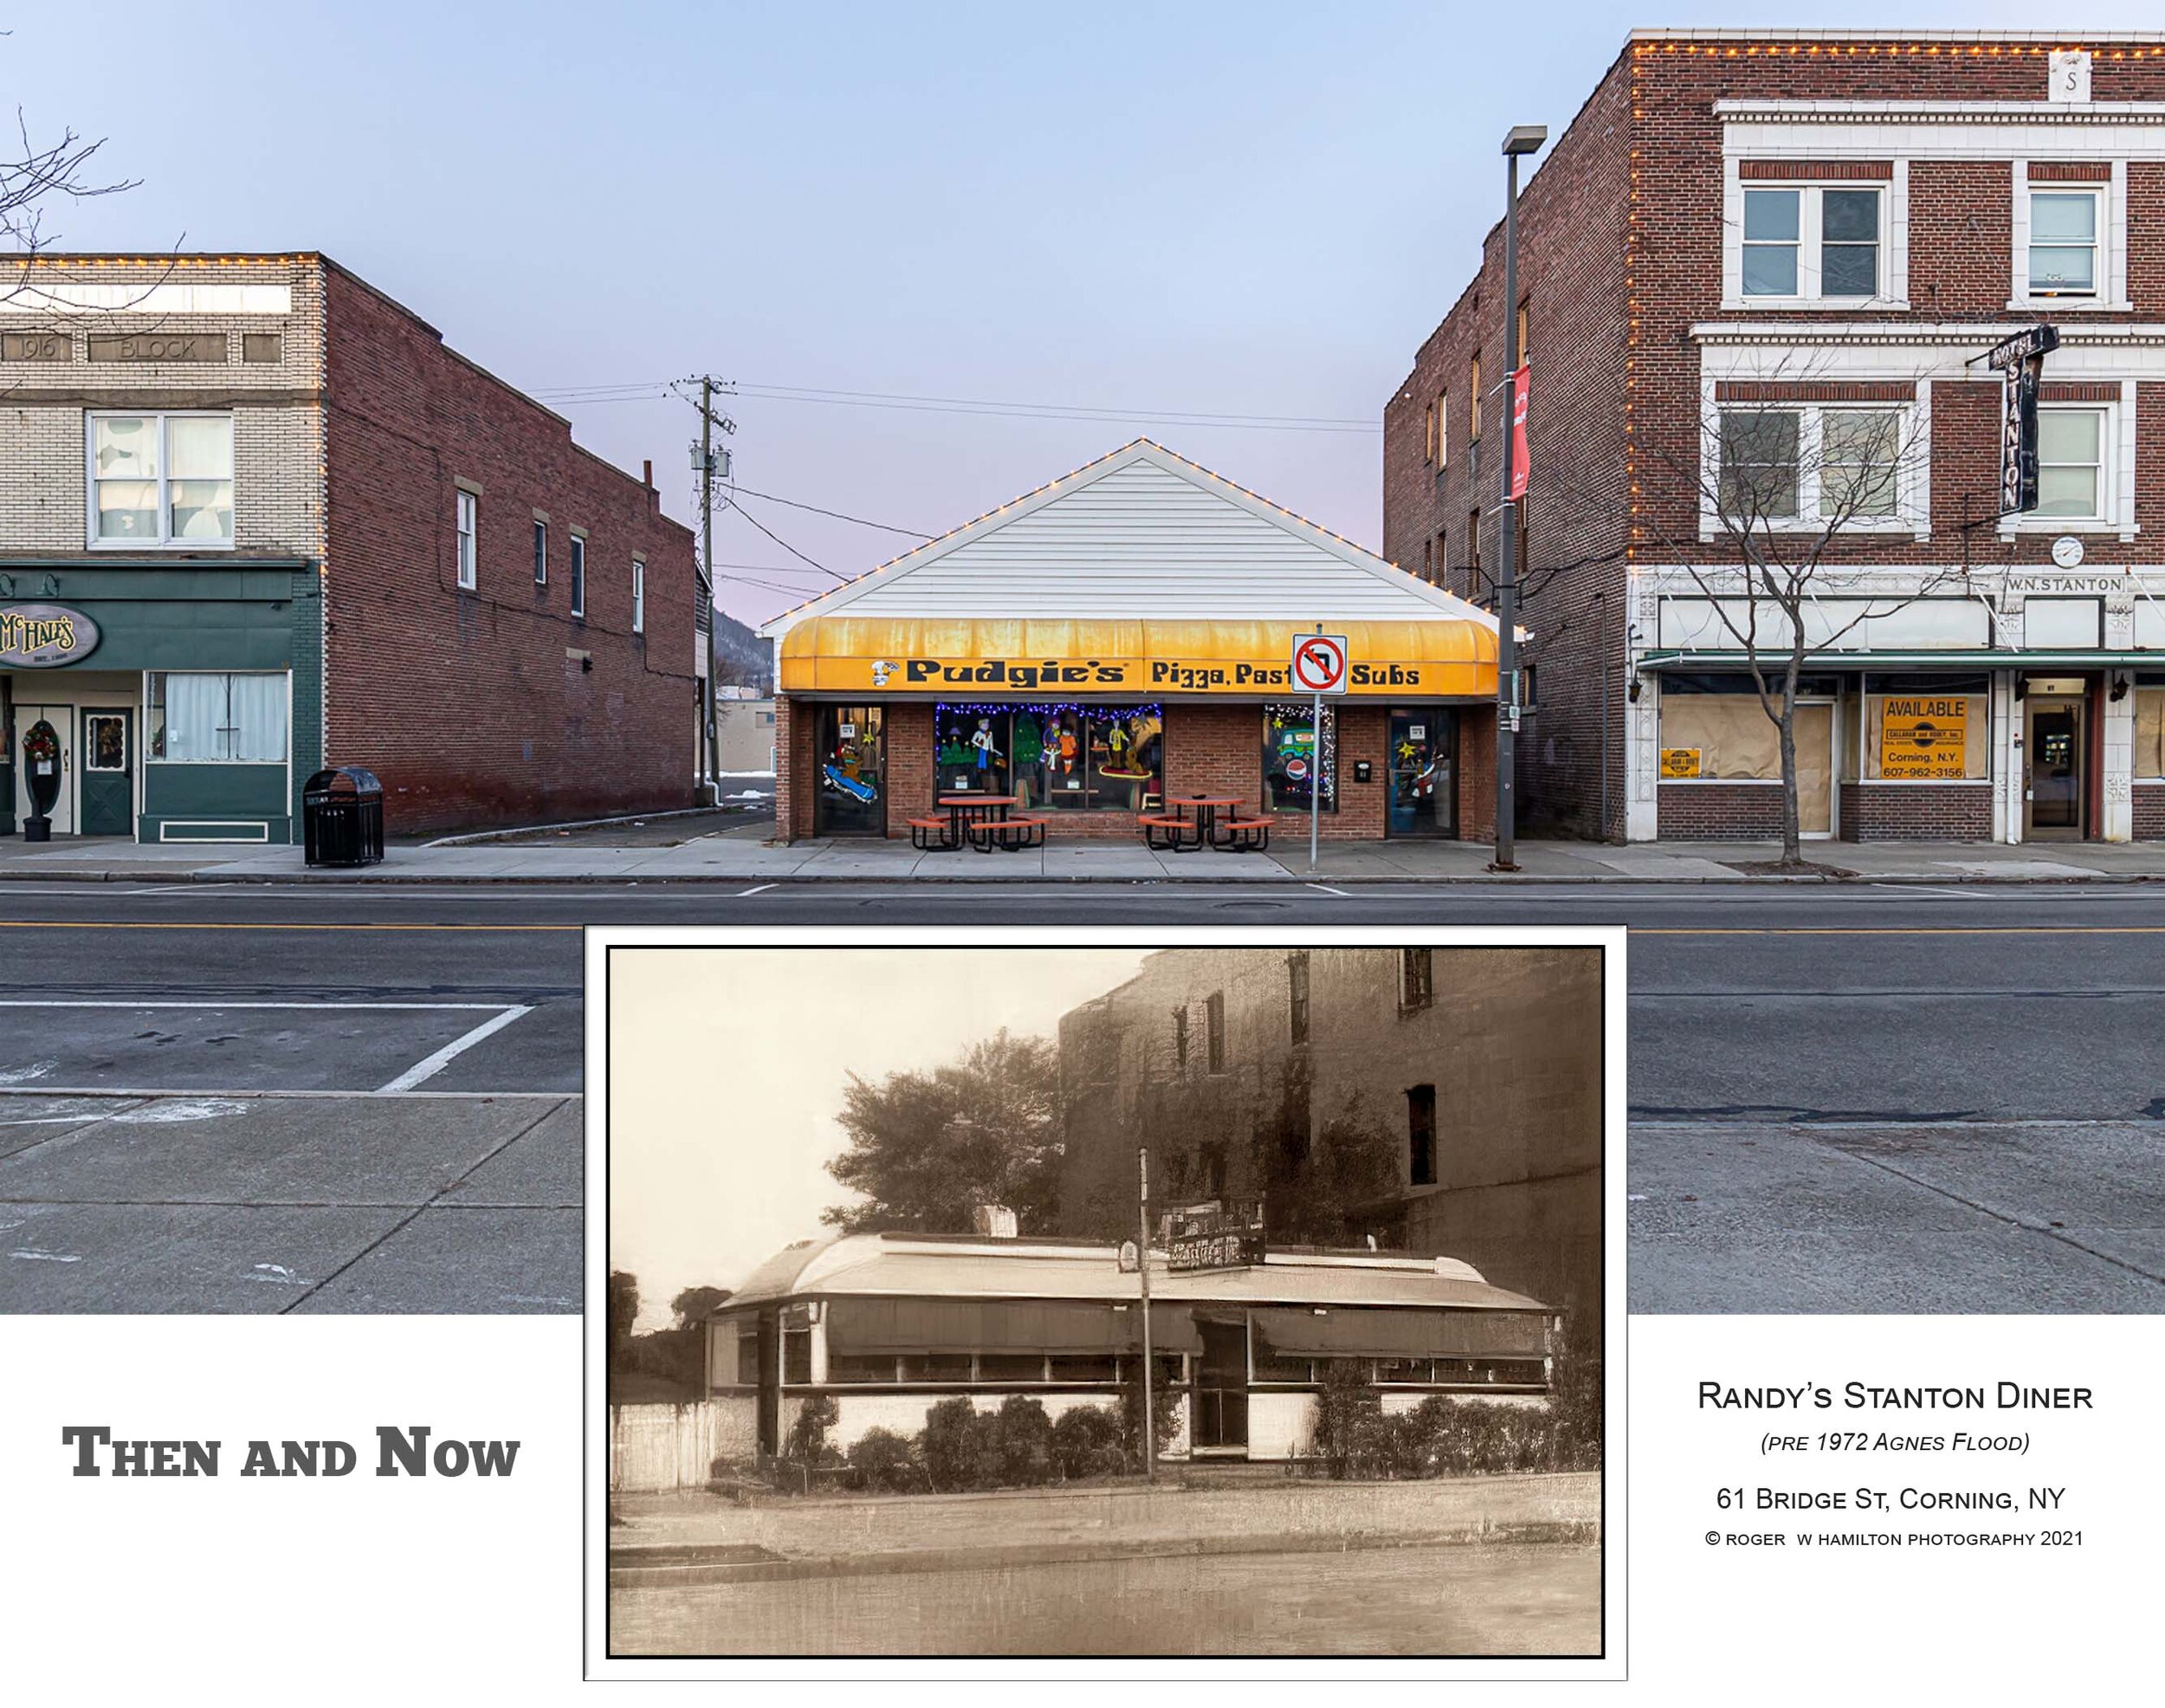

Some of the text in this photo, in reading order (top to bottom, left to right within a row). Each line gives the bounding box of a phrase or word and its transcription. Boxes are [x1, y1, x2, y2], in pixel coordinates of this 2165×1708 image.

[2065, 72, 2077, 91] S
[21, 337, 56, 359] 1916
[120, 340, 197, 359] BLOCK
[2004, 360, 2021, 509] STANTON
[907, 660, 1419, 689] Pudgie's Pizza, Past Subs
[1886, 701, 1965, 717] AVAILABLE
[1889, 752, 1959, 763] Corning, N.Y.
[1884, 767, 1962, 777] 607-962-3156
